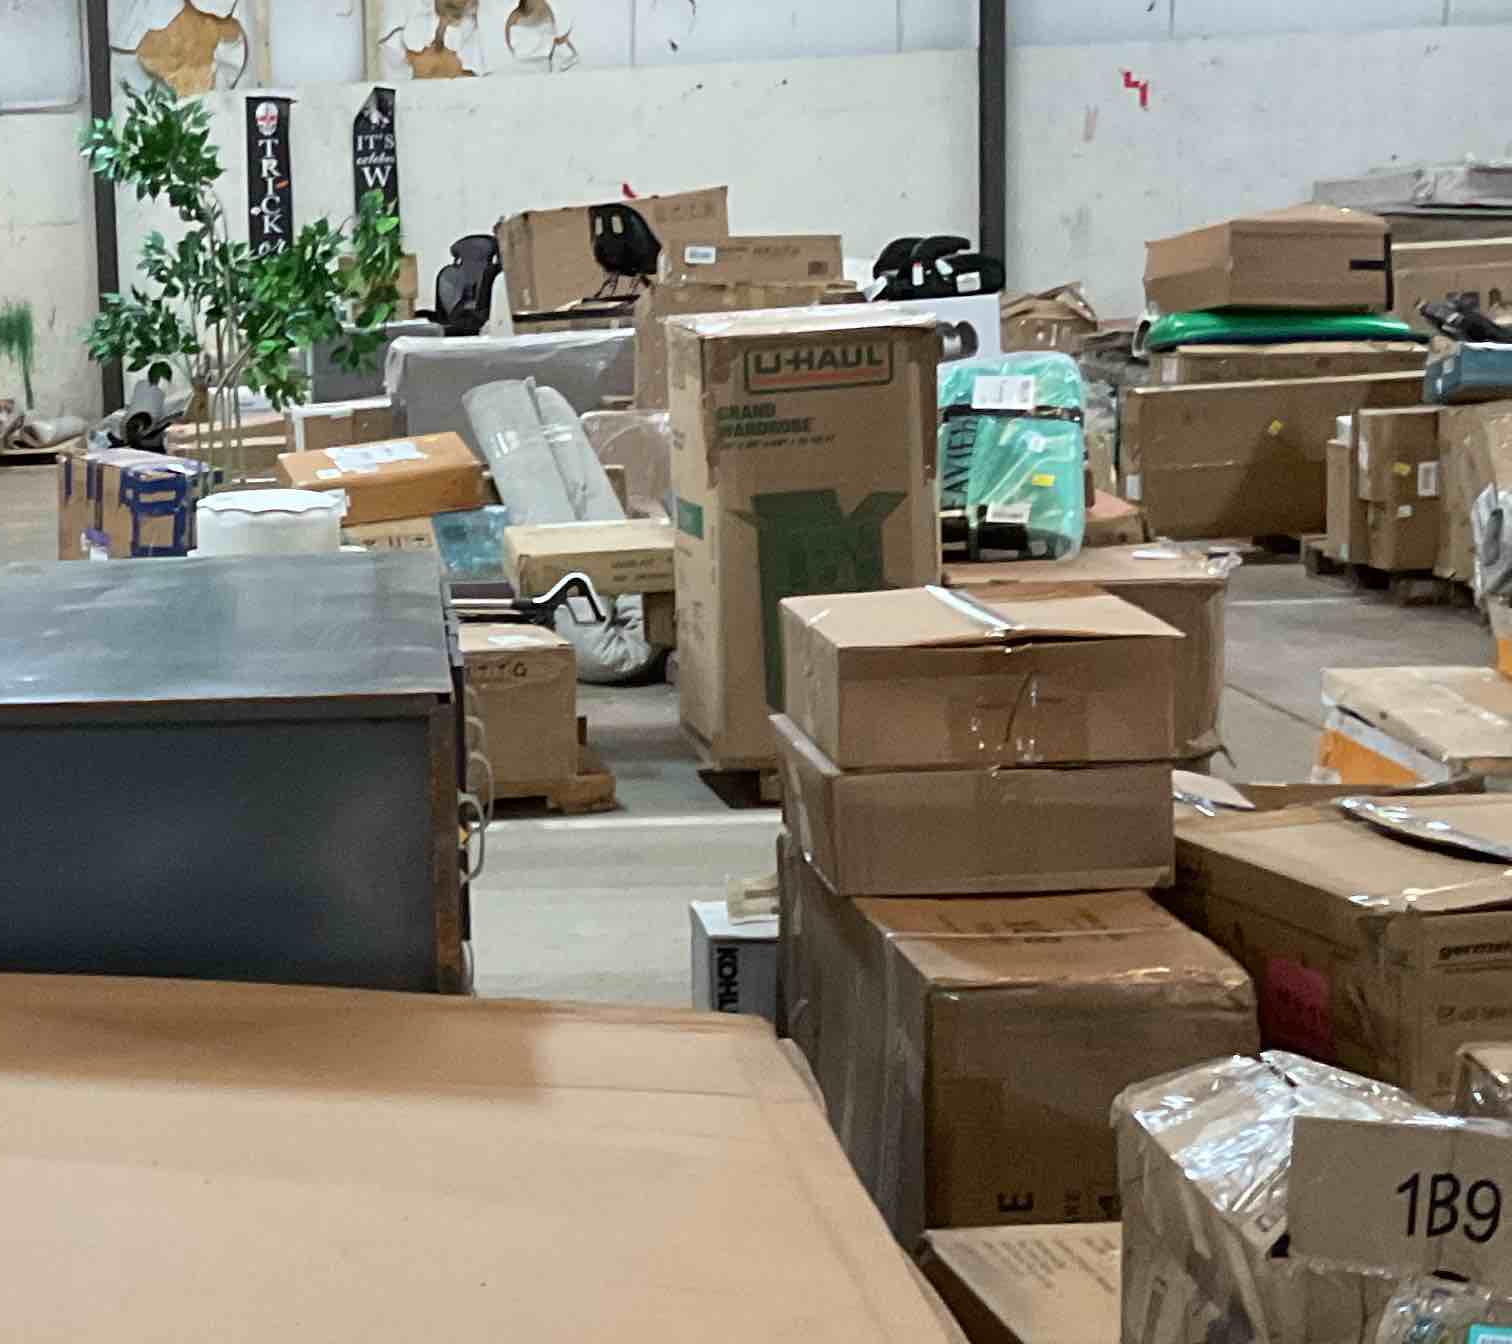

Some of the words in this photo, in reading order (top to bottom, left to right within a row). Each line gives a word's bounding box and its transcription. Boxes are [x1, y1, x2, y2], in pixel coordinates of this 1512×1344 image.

[257, 138, 284, 235] TRICK
[754, 344, 885, 374] U-HAUL
[716, 947, 739, 1013] KOHL
[1396, 1171, 1503, 1244] 1B9
